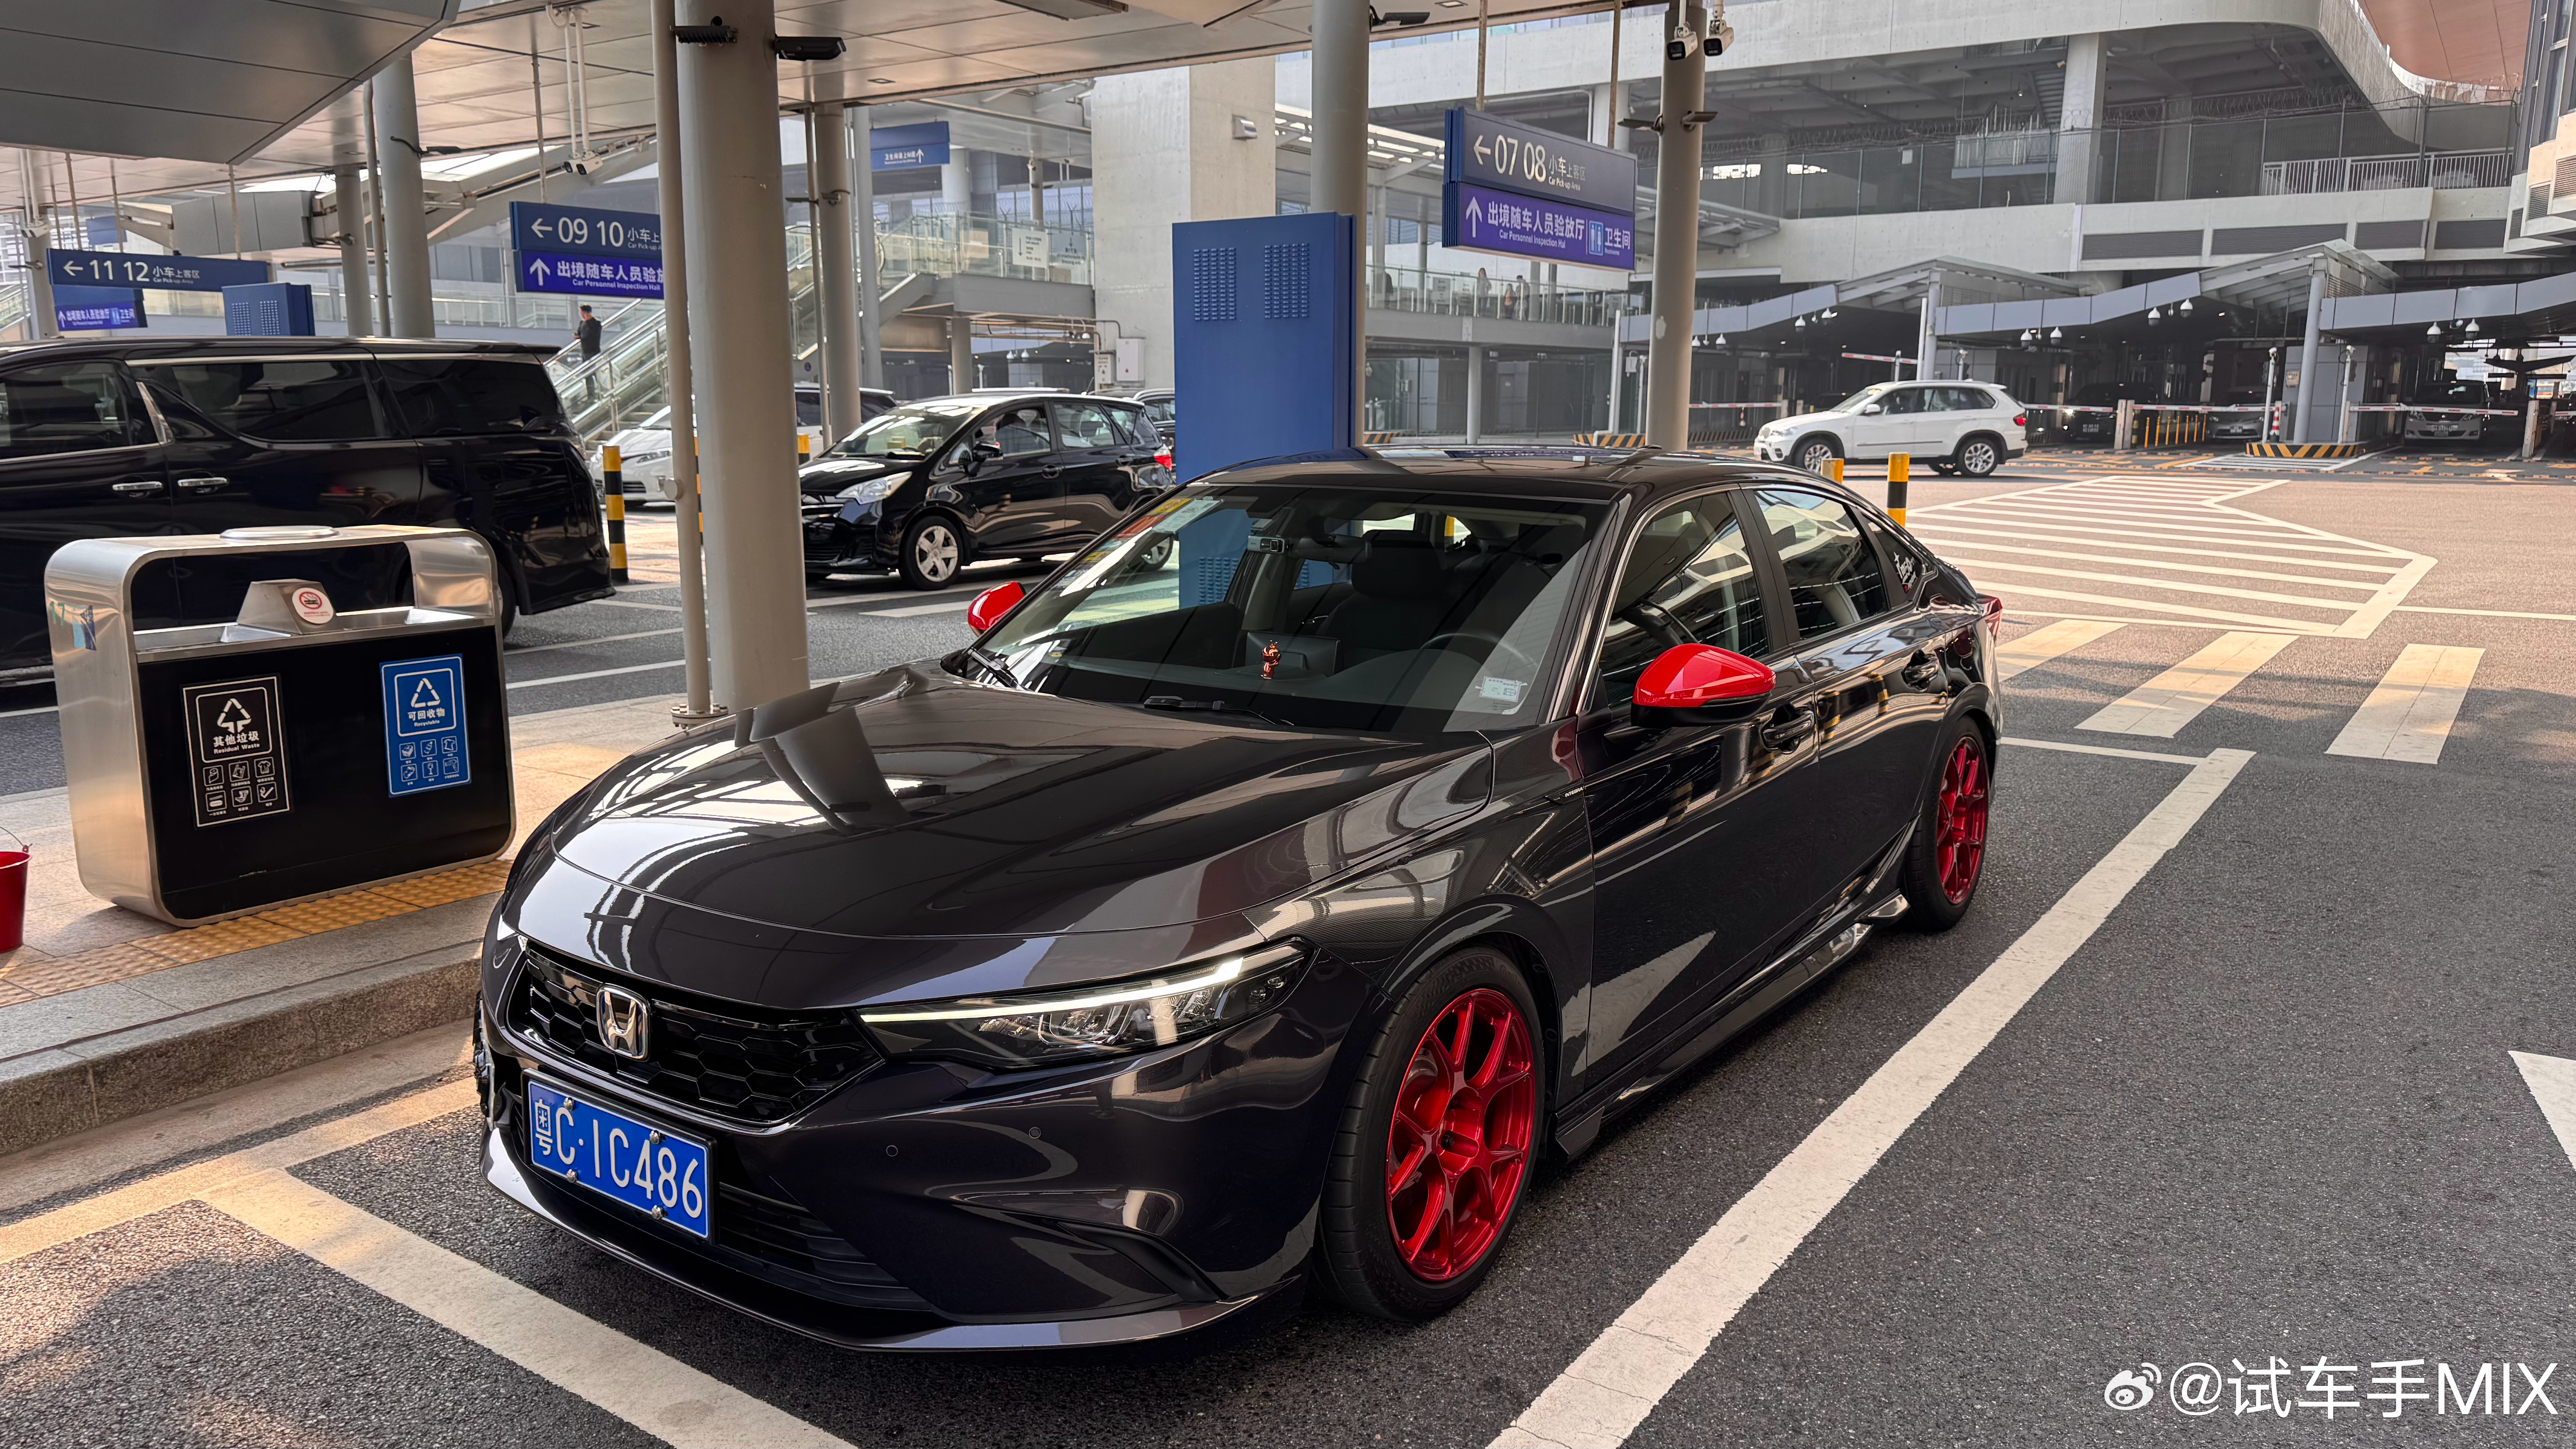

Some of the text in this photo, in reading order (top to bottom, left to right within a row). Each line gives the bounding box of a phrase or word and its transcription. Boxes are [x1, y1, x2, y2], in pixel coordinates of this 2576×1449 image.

[1495, 135, 1546, 183] 07 08
[1549, 154, 1586, 181] 小车上客区
[558, 217, 624, 247] 09 10
[1488, 201, 1630, 250] 出境随车人员验放厅 卫生间
[1499, 229, 1508, 239] Car
[1509, 230, 1533, 244] Personnel
[1534, 235, 1557, 247] Inspection
[90, 259, 150, 282] 11 12
[152, 265, 200, 280] 小车上客区
[585, 280, 616, 289] Personnel
[617, 282, 648, 291] Inspection
[407, 708, 445, 721] 可回收物
[414, 719, 441, 727] Recyclable
[213, 731, 260, 748] 其他垃圾
[214, 745, 239, 754] Residual
